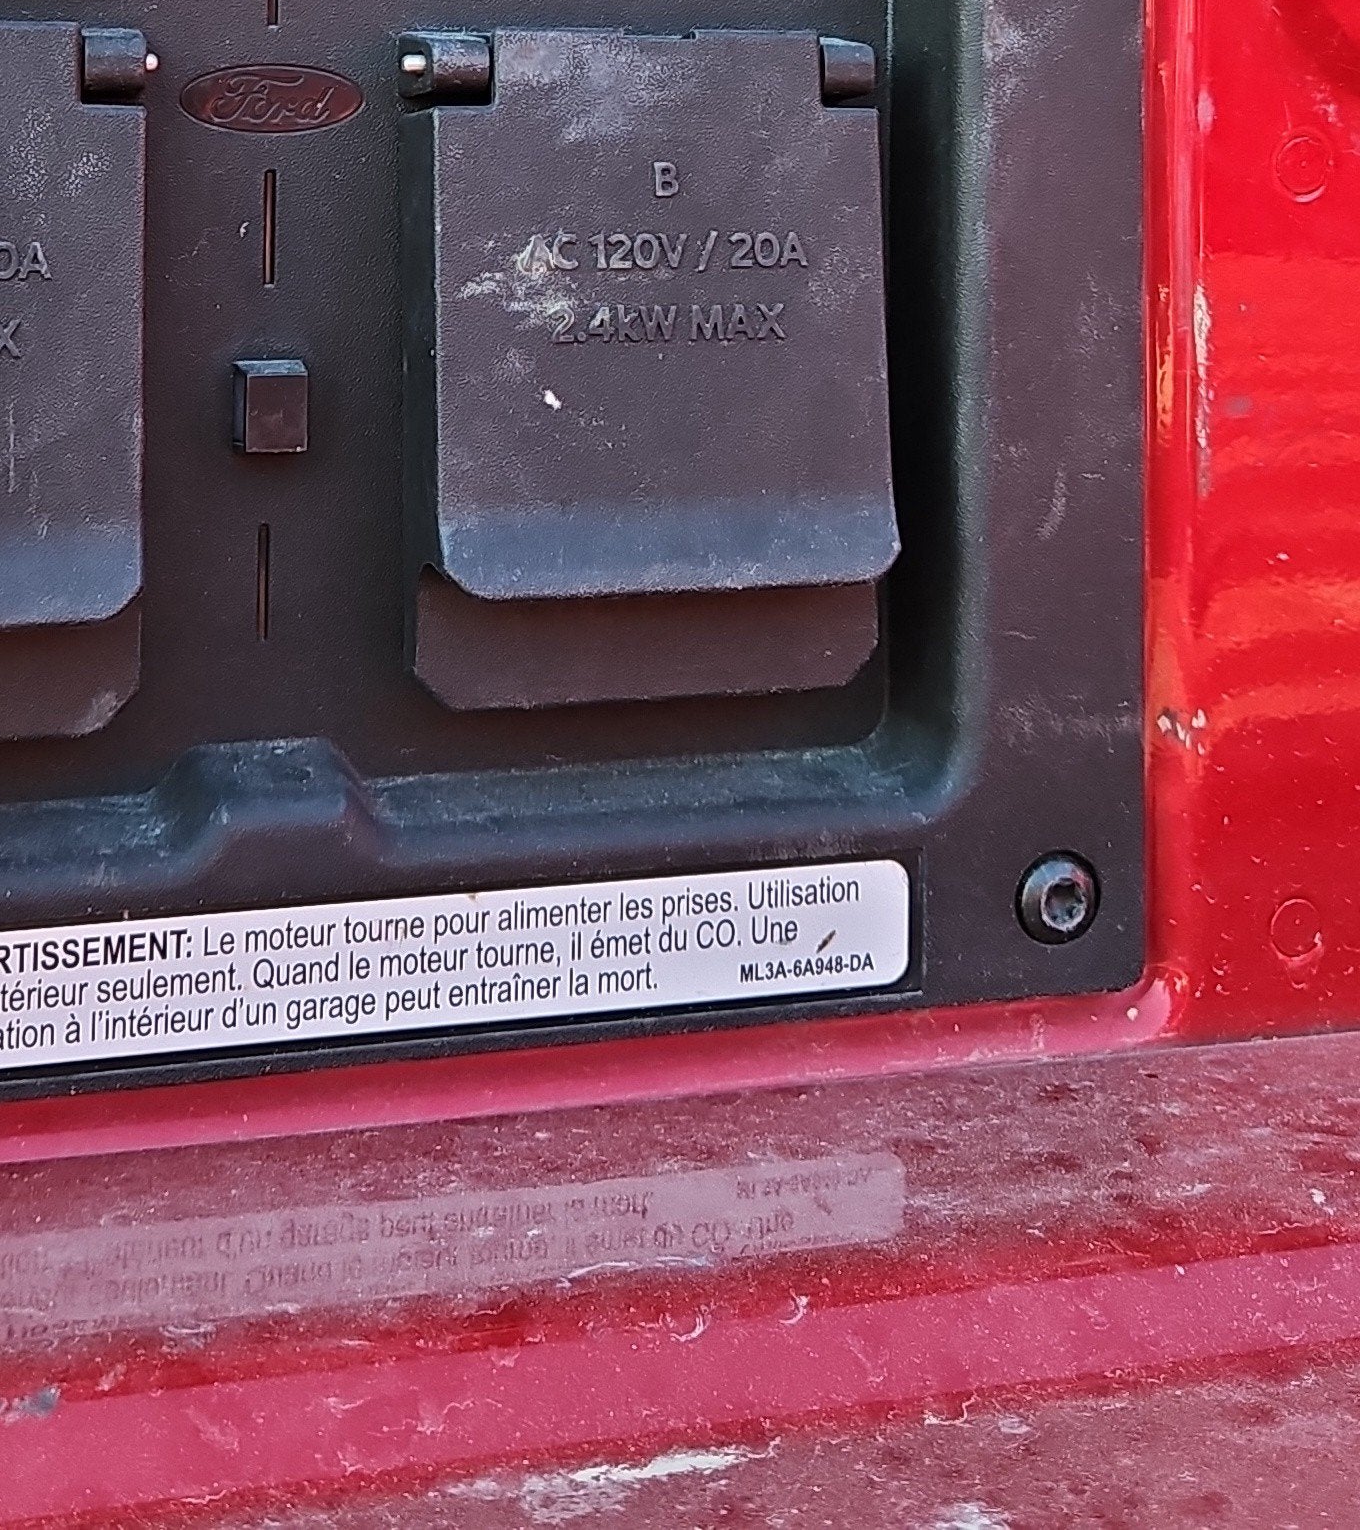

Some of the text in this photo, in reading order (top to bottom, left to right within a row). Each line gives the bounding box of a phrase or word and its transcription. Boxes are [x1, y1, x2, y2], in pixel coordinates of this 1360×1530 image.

[209, 72, 335, 123] Ford
[652, 162, 679, 198] B
[519, 229, 809, 273] AC 120V / 20A
[549, 302, 787, 345] 2.4kW MAX
[204, 926, 235, 956] Le
[245, 919, 336, 953] moteur
[344, 916, 424, 944] tourne
[434, 911, 490, 944] pour
[498, 897, 612, 931] alimenter
[620, 893, 653, 921] les
[662, 888, 738, 925] prises.
[749, 876, 860, 910] Utilisation
[97, 962, 243, 1003] seulement.
[253, 952, 339, 989] Quand
[350, 951, 370, 980] le
[380, 946, 468, 977] moteur
[476, 941, 561, 969] tourne,
[572, 932, 582, 961] il
[591, 927, 651, 959] émet
[659, 921, 687, 952] du
[697, 919, 742, 949] CO.
[752, 916, 798, 945] Une
[740, 953, 874, 983] ML3A-6A948-DA
[65, 1013, 80, 1043] à
[92, 1004, 214, 1041] l'intérieur
[222, 997, 276, 1028] d'un
[287, 991, 375, 1029] garage
[386, 981, 440, 1021] peut
[449, 973, 561, 1007] entraîner
[570, 968, 589, 996] la
[599, 962, 658, 993] mort.
